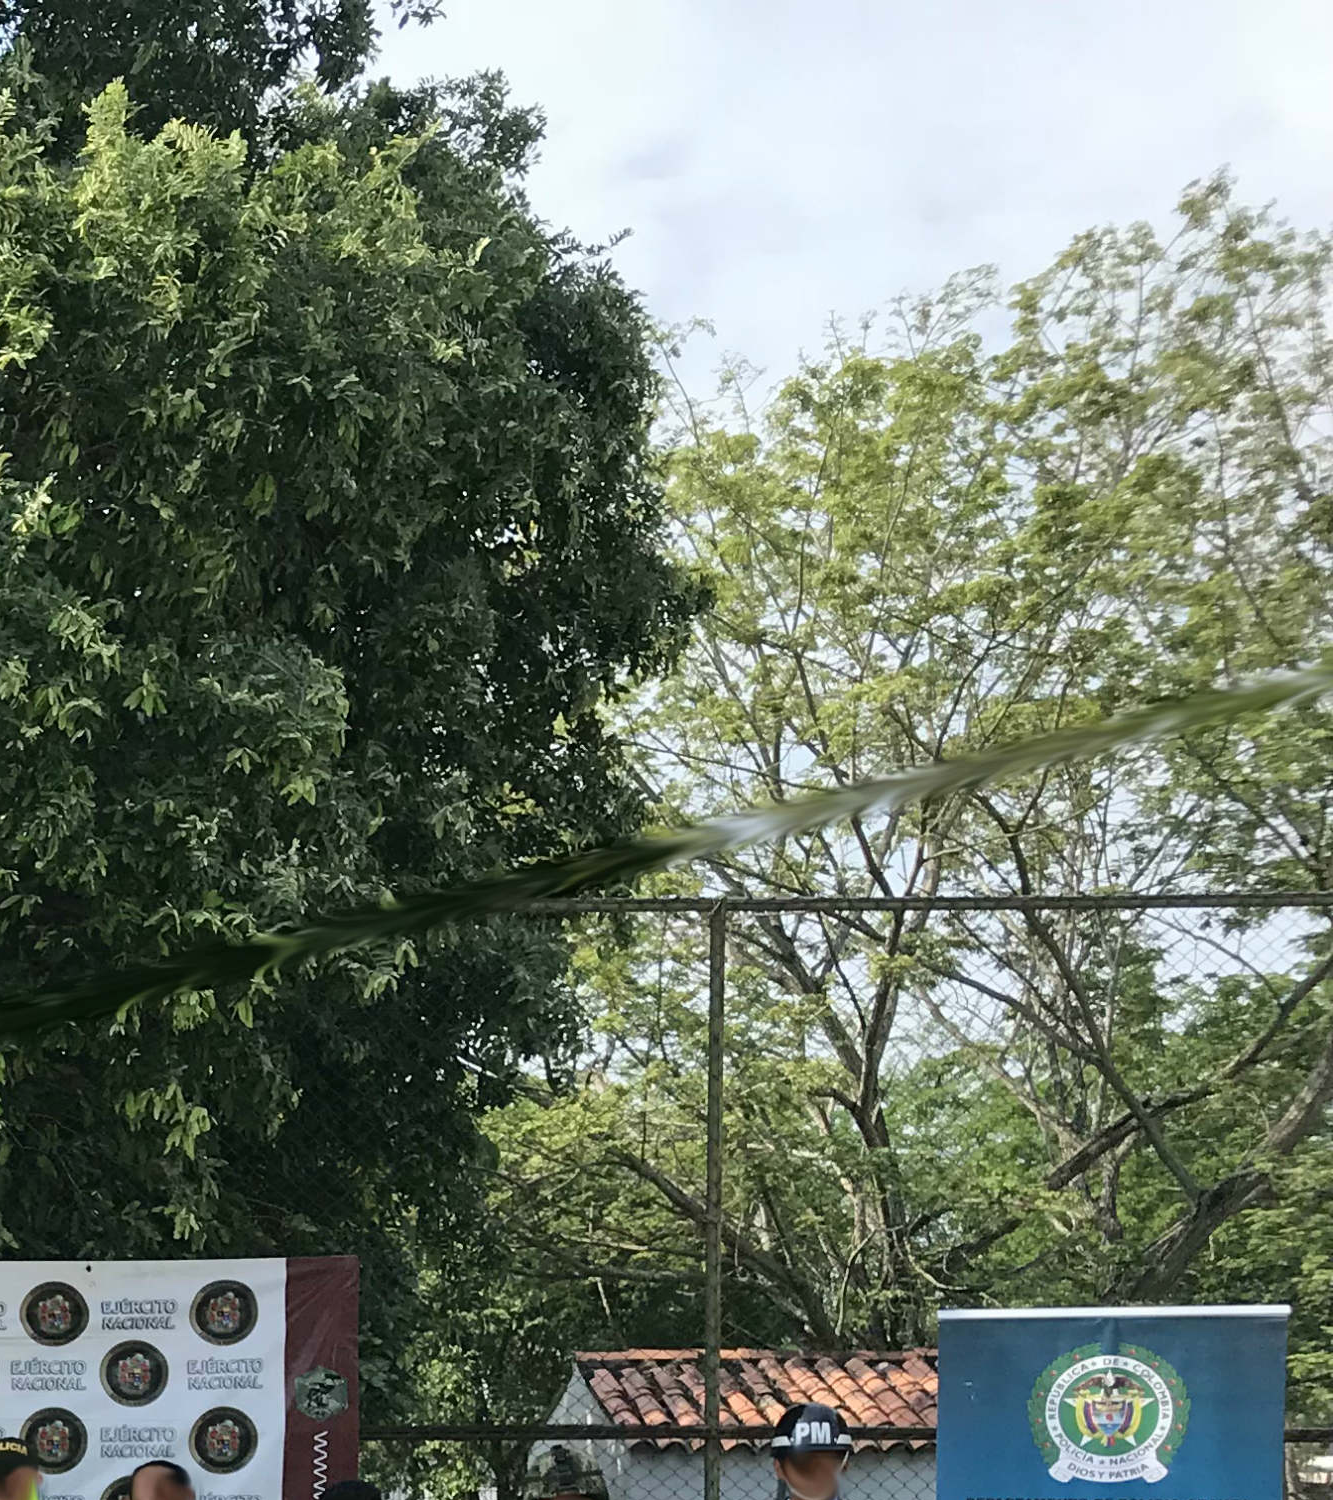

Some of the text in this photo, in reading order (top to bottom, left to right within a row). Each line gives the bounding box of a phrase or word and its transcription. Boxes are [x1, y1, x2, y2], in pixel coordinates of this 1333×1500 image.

[101, 1298, 178, 1315] EJÉRCITO
[101, 1315, 176, 1330] NACIONAL
[10, 1357, 87, 1376] EJÉRCITO
[187, 1357, 263, 1375] EJÉRCITO
[11, 1376, 87, 1391] NACIONAL
[188, 1375, 264, 1390] NACIONAL
[1103, 1358, 1120, 1366] DE
[1133, 1362, 1171, 1420] COLOMBIA
[100, 1424, 177, 1442] EJÉRCITO
[795, 1421, 831, 1446] PM
[100, 1443, 175, 1458] NACIONAL
[1109, 1433, 1164, 1466] NACIONAL
[1067, 1462, 1095, 1478] DIOS
[1108, 1463, 1150, 1479] PATRIA
